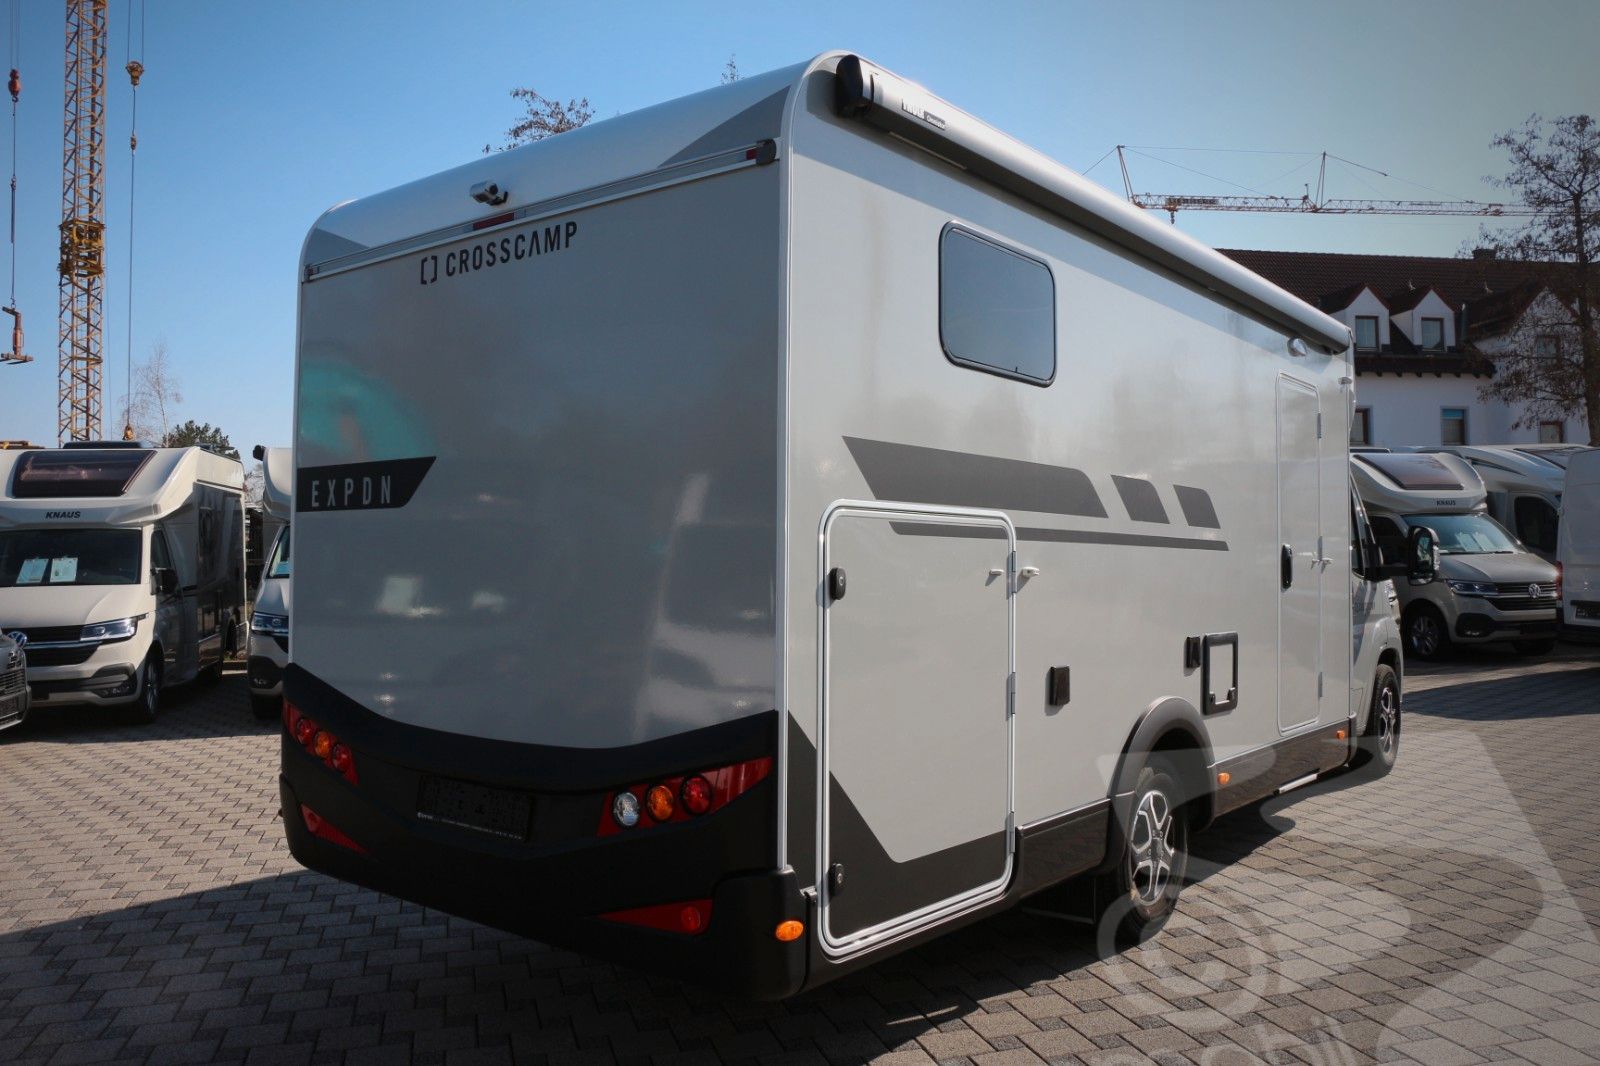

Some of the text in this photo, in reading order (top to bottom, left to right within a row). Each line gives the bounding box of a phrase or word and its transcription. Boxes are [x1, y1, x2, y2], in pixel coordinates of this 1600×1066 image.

[446, 221, 578, 277] CROSSCAMP
[311, 475, 391, 507] EXPDN
[45, 510, 81, 519] KNAUS
